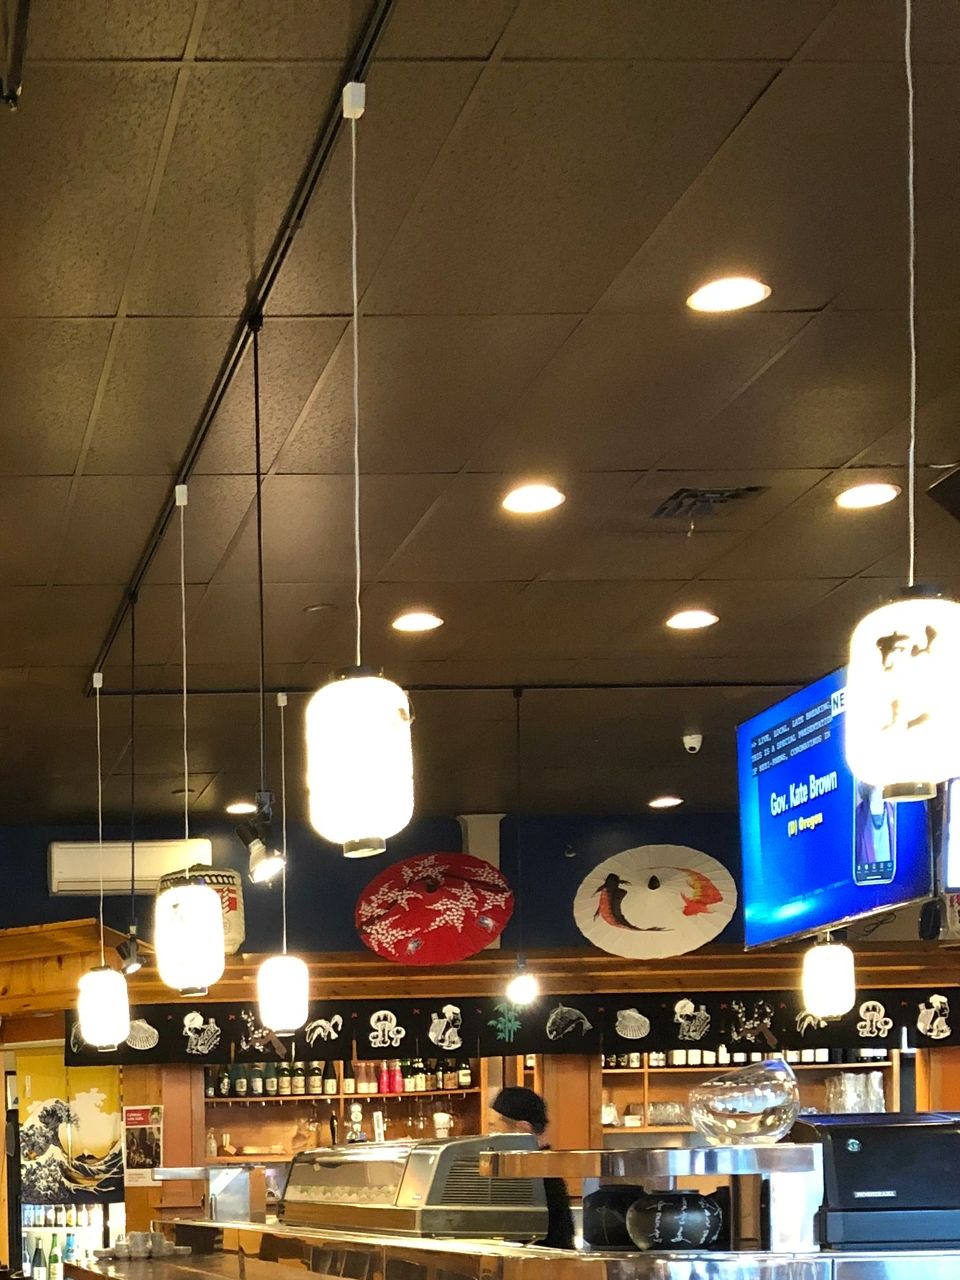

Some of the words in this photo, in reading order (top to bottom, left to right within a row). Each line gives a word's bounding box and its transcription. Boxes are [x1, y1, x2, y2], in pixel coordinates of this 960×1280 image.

[776, 733, 797, 750] SPECIAL
[770, 792, 789, 816] Gov.
[789, 782, 808, 808] Kate
[809, 770, 838, 799] Brown
[787, 819, 798, 837] (D)
[798, 812, 823, 831] Oregon
